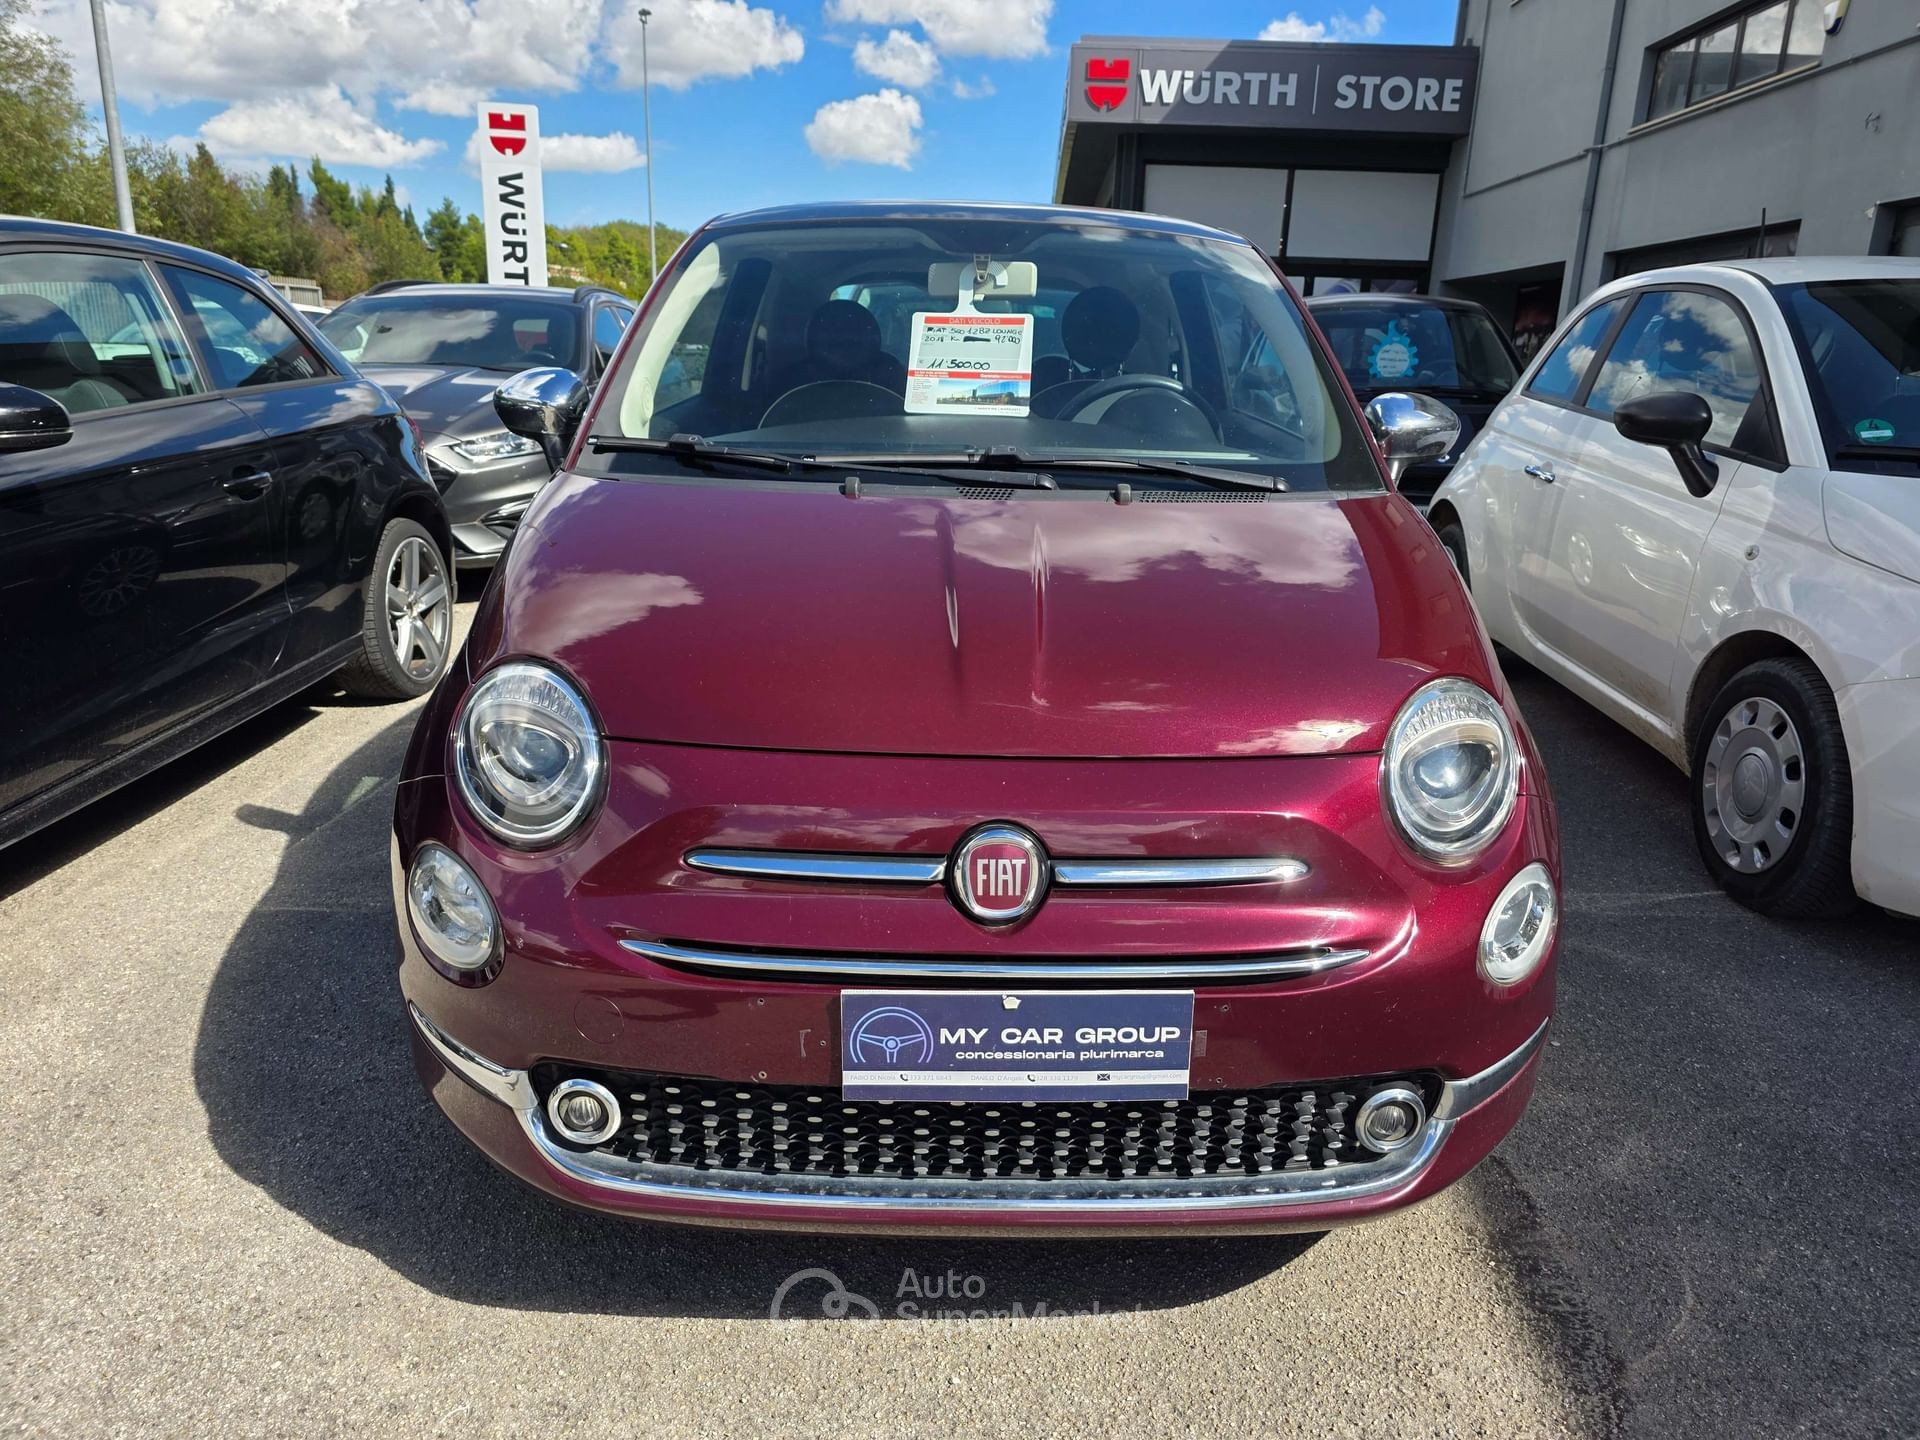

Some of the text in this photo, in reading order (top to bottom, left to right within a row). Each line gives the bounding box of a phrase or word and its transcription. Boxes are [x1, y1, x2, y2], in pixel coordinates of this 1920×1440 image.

[1140, 68, 1463, 112] WÜRTH STORE
[498, 172, 530, 286] WÜRT
[967, 317, 1001, 325] VEICOLO
[977, 859, 1027, 896] FIAT
[939, 1026, 1181, 1044] MY CAR GROUP
[955, 1049, 1165, 1061] concessionaria plurimarca
